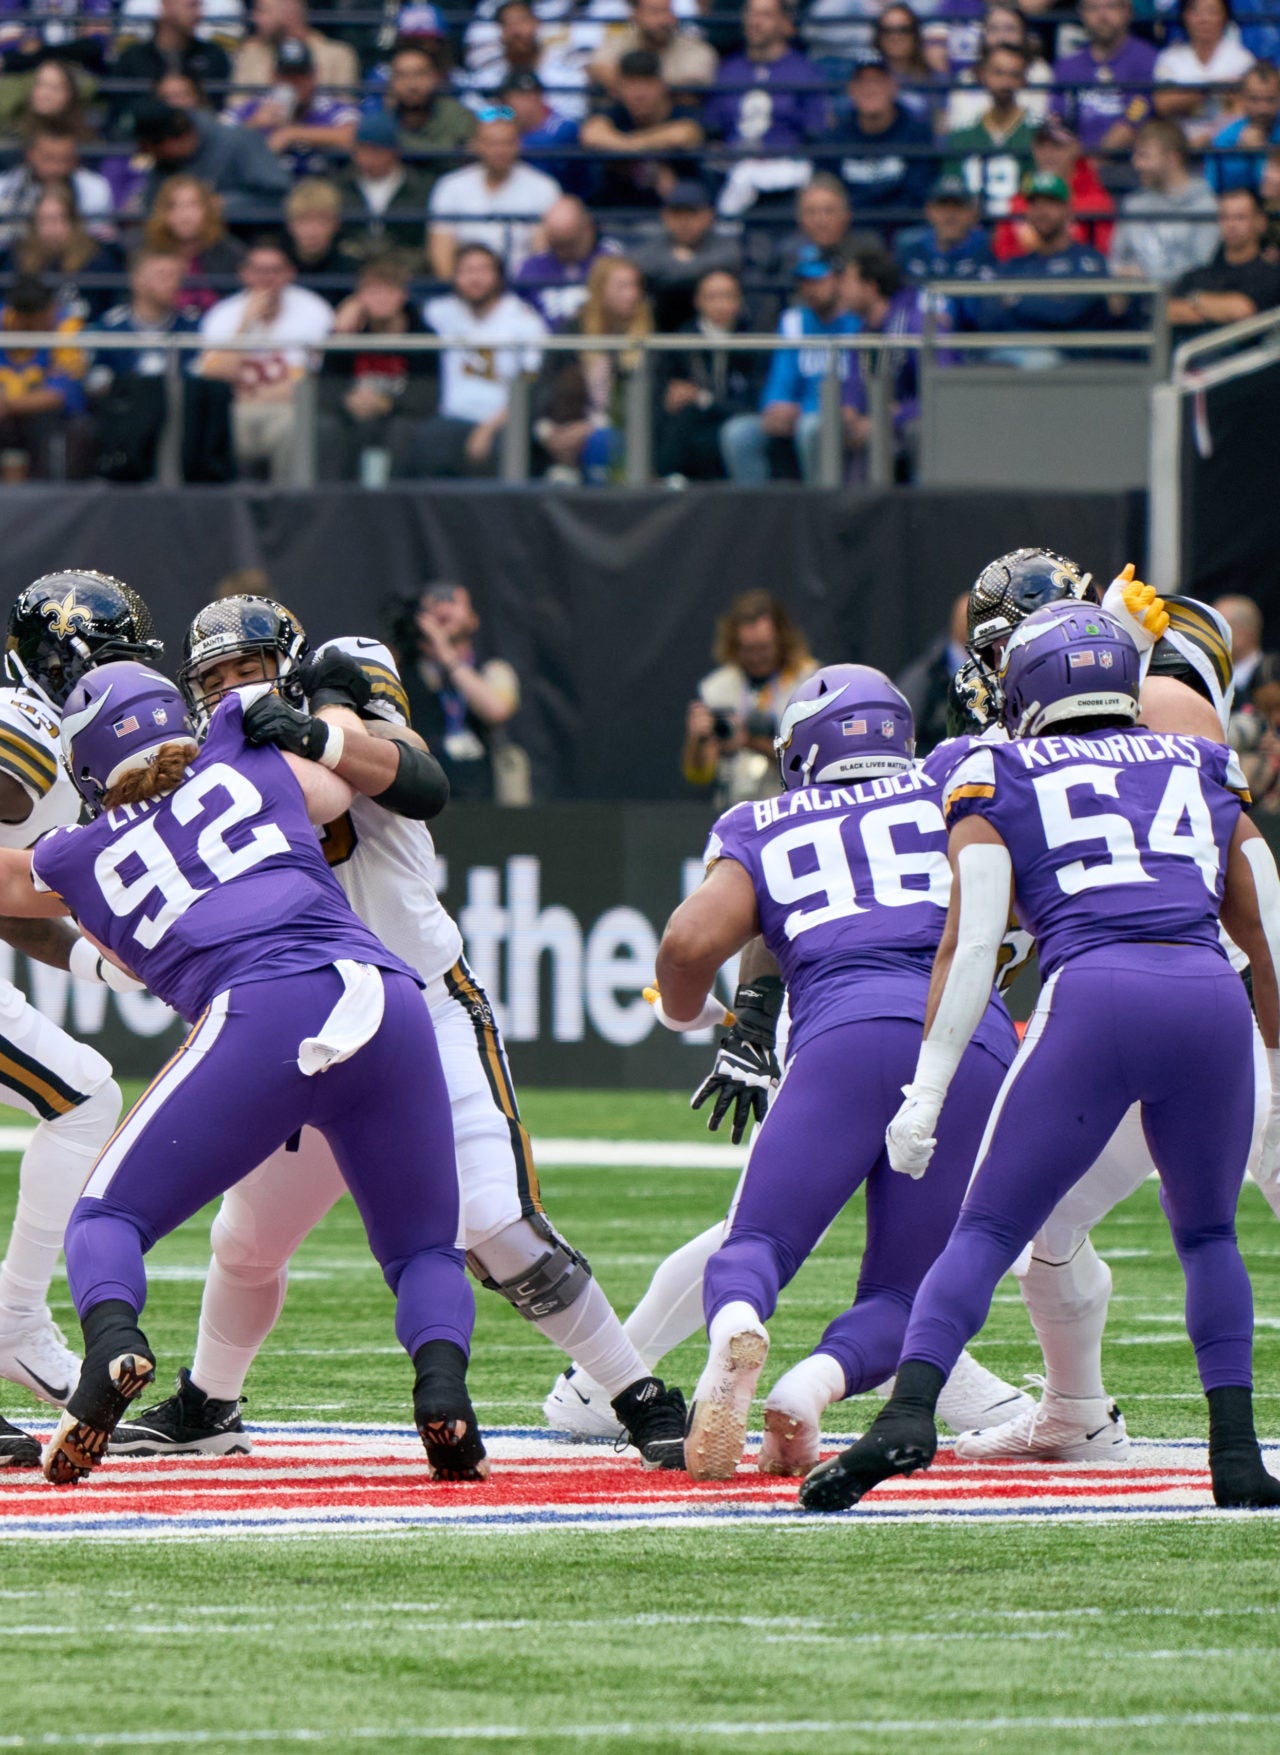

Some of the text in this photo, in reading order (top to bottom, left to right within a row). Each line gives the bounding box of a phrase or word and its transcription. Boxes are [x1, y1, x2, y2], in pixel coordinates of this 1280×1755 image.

[1016, 733, 1202, 769] KENDRICKS
[1077, 698, 1120, 707] CHOOSE LOVE
[752, 767, 937, 831] BLACKLOCK
[839, 763, 864, 772] BLACK
[94, 762, 292, 951] 92
[760, 799, 954, 941] 96
[1032, 763, 1220, 898] 54
[458, 853, 660, 1046] the
